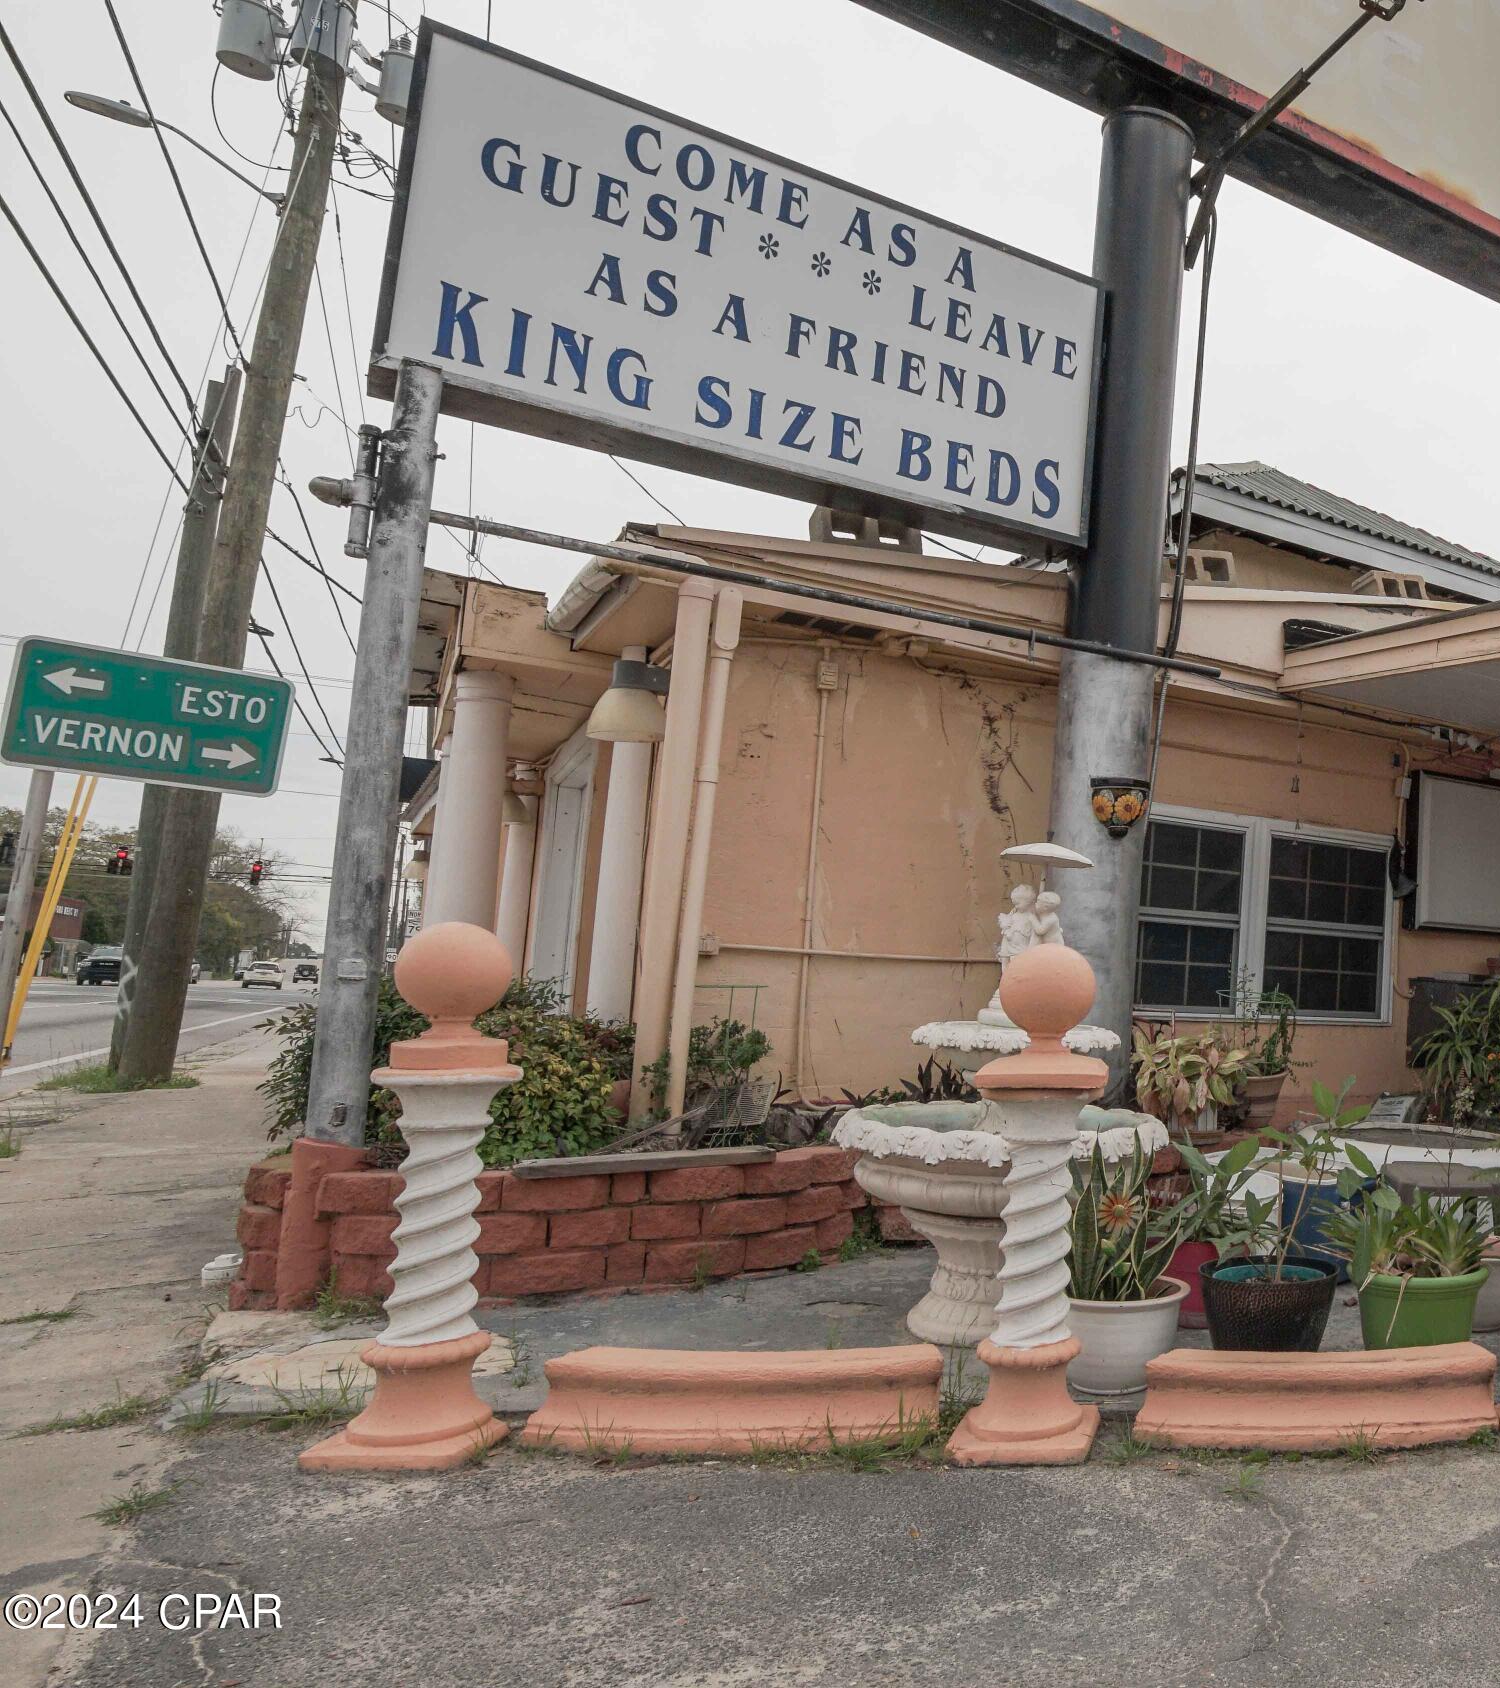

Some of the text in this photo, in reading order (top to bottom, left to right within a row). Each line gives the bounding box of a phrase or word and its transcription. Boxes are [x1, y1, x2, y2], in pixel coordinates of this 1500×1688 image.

[480, 137, 725, 258] GUEST
[908, 284, 1078, 381] LEAVE
[624, 124, 977, 294] COME AS A
[431, 279, 1061, 520] KING SIZE BEDS
[583, 252, 1007, 419] AS A FRIEND
[33, 714, 185, 762] VERNON
[180, 685, 267, 724] ESTO
